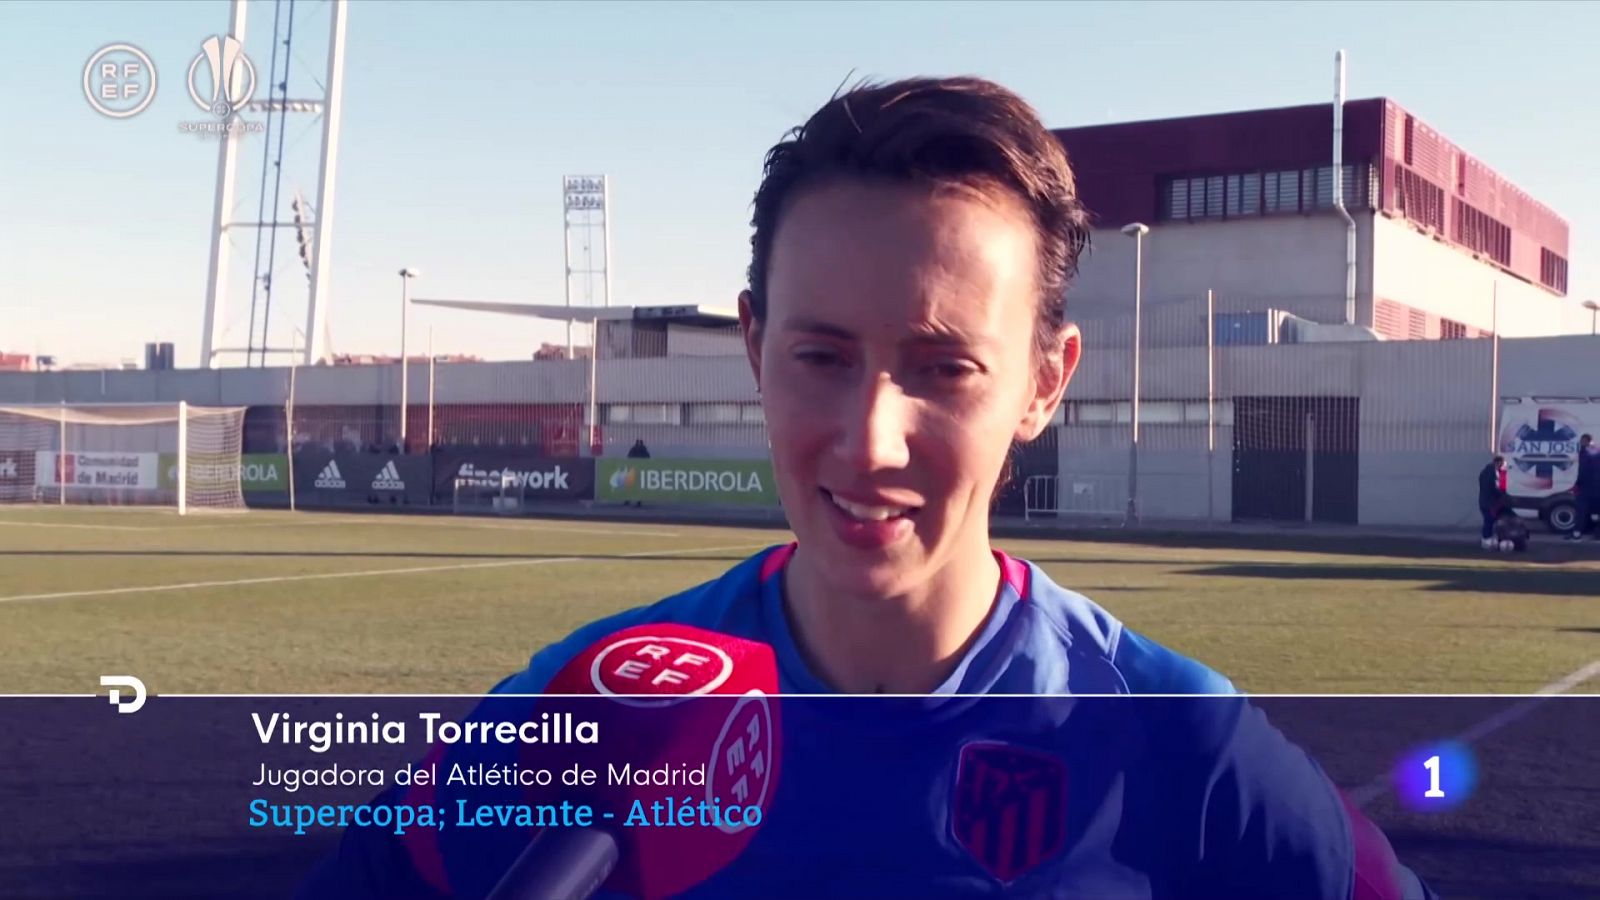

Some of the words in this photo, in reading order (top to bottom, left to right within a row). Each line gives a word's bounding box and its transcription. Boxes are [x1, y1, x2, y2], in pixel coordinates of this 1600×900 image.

[1508, 440, 1541, 454] SAN
[77, 455, 140, 467] Comunidad
[78, 472, 93, 484] de
[95, 471, 139, 486] Madrid
[314, 479, 346, 489] adidas
[371, 480, 405, 490] adidas
[640, 469, 763, 492] IBERDROLA
